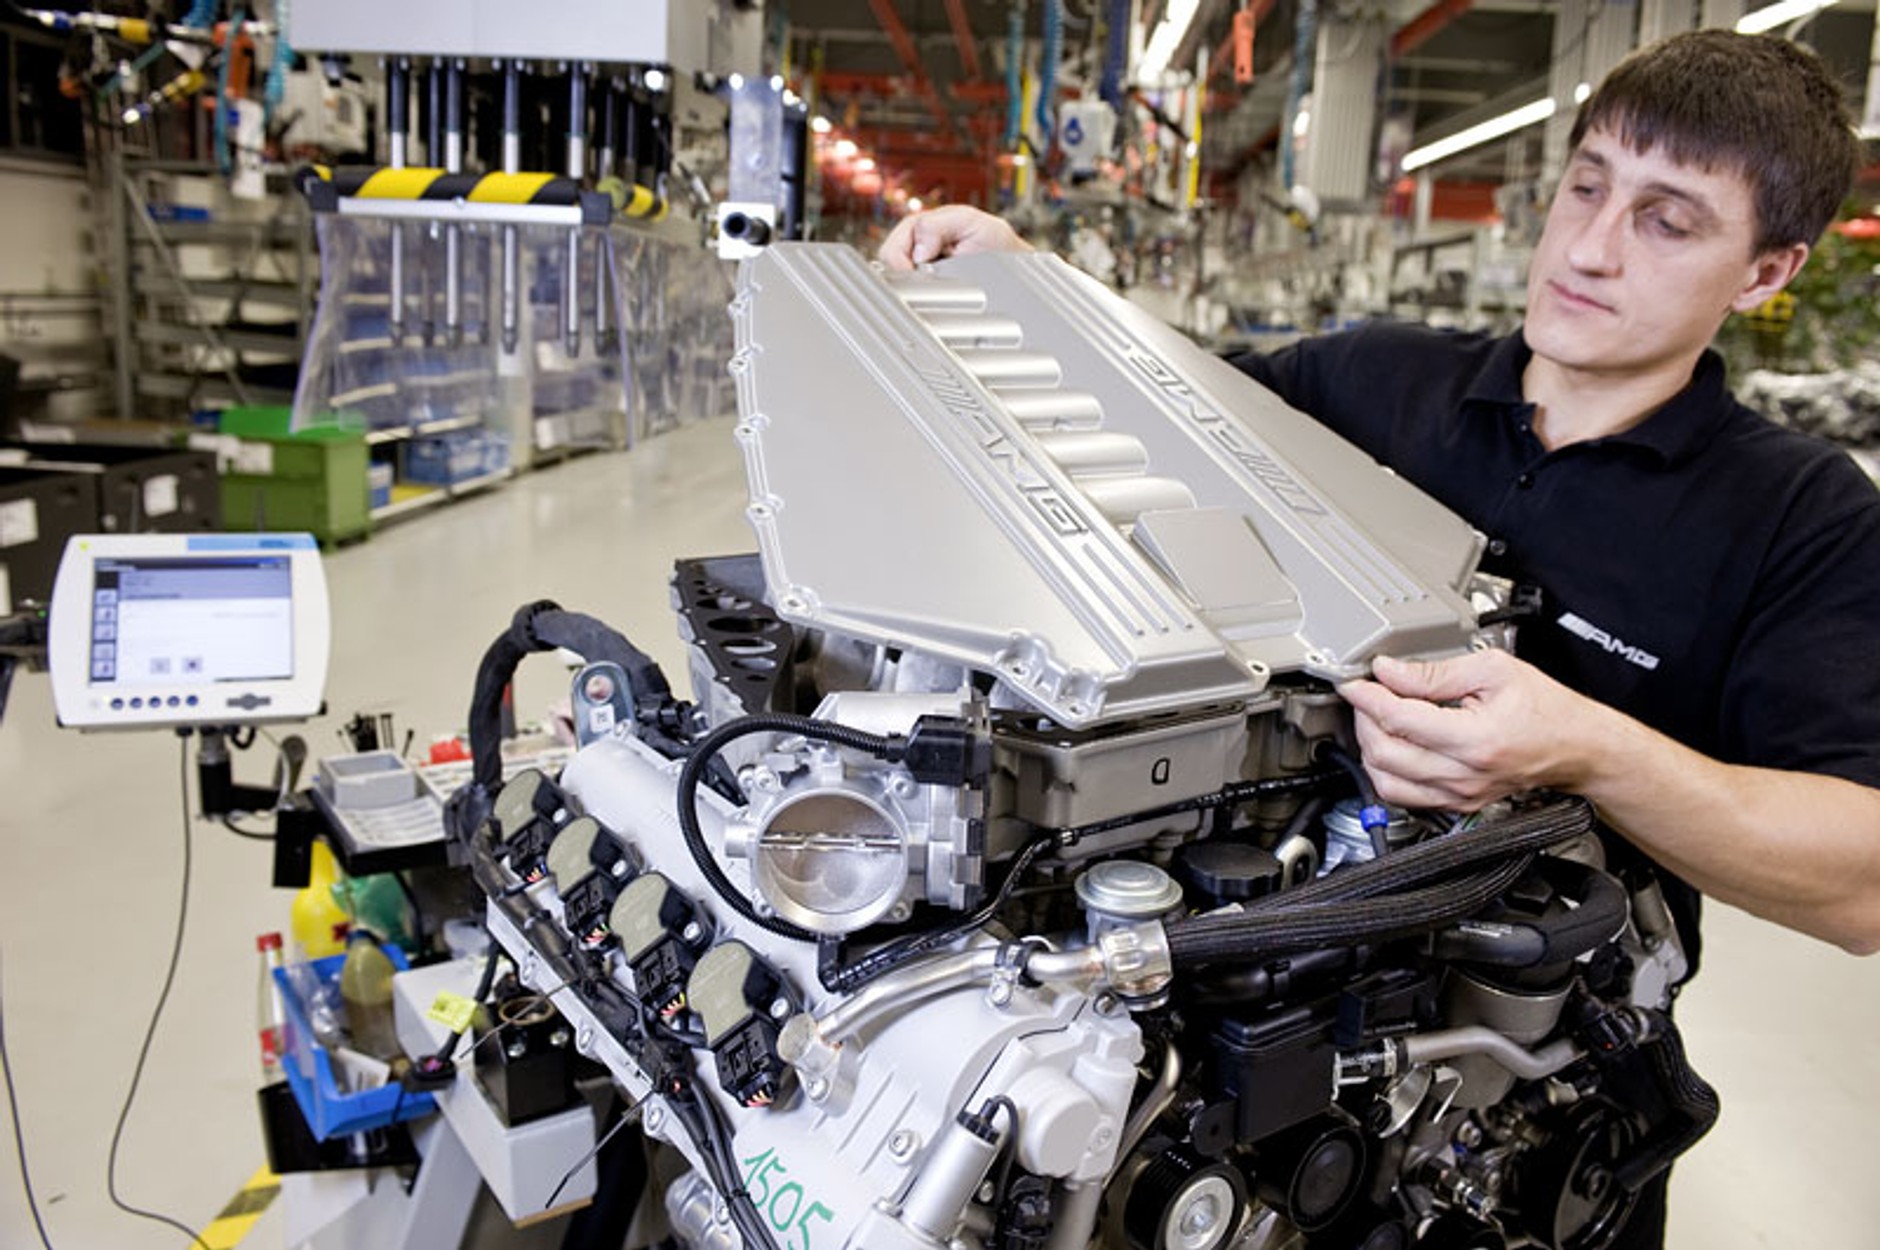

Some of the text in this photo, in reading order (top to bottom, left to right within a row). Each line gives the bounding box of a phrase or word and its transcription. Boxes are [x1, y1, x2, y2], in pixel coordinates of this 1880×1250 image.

[944, 404, 1091, 538] AMG
[1580, 622, 1660, 670] AMG
[743, 1147, 834, 1250] 1505
